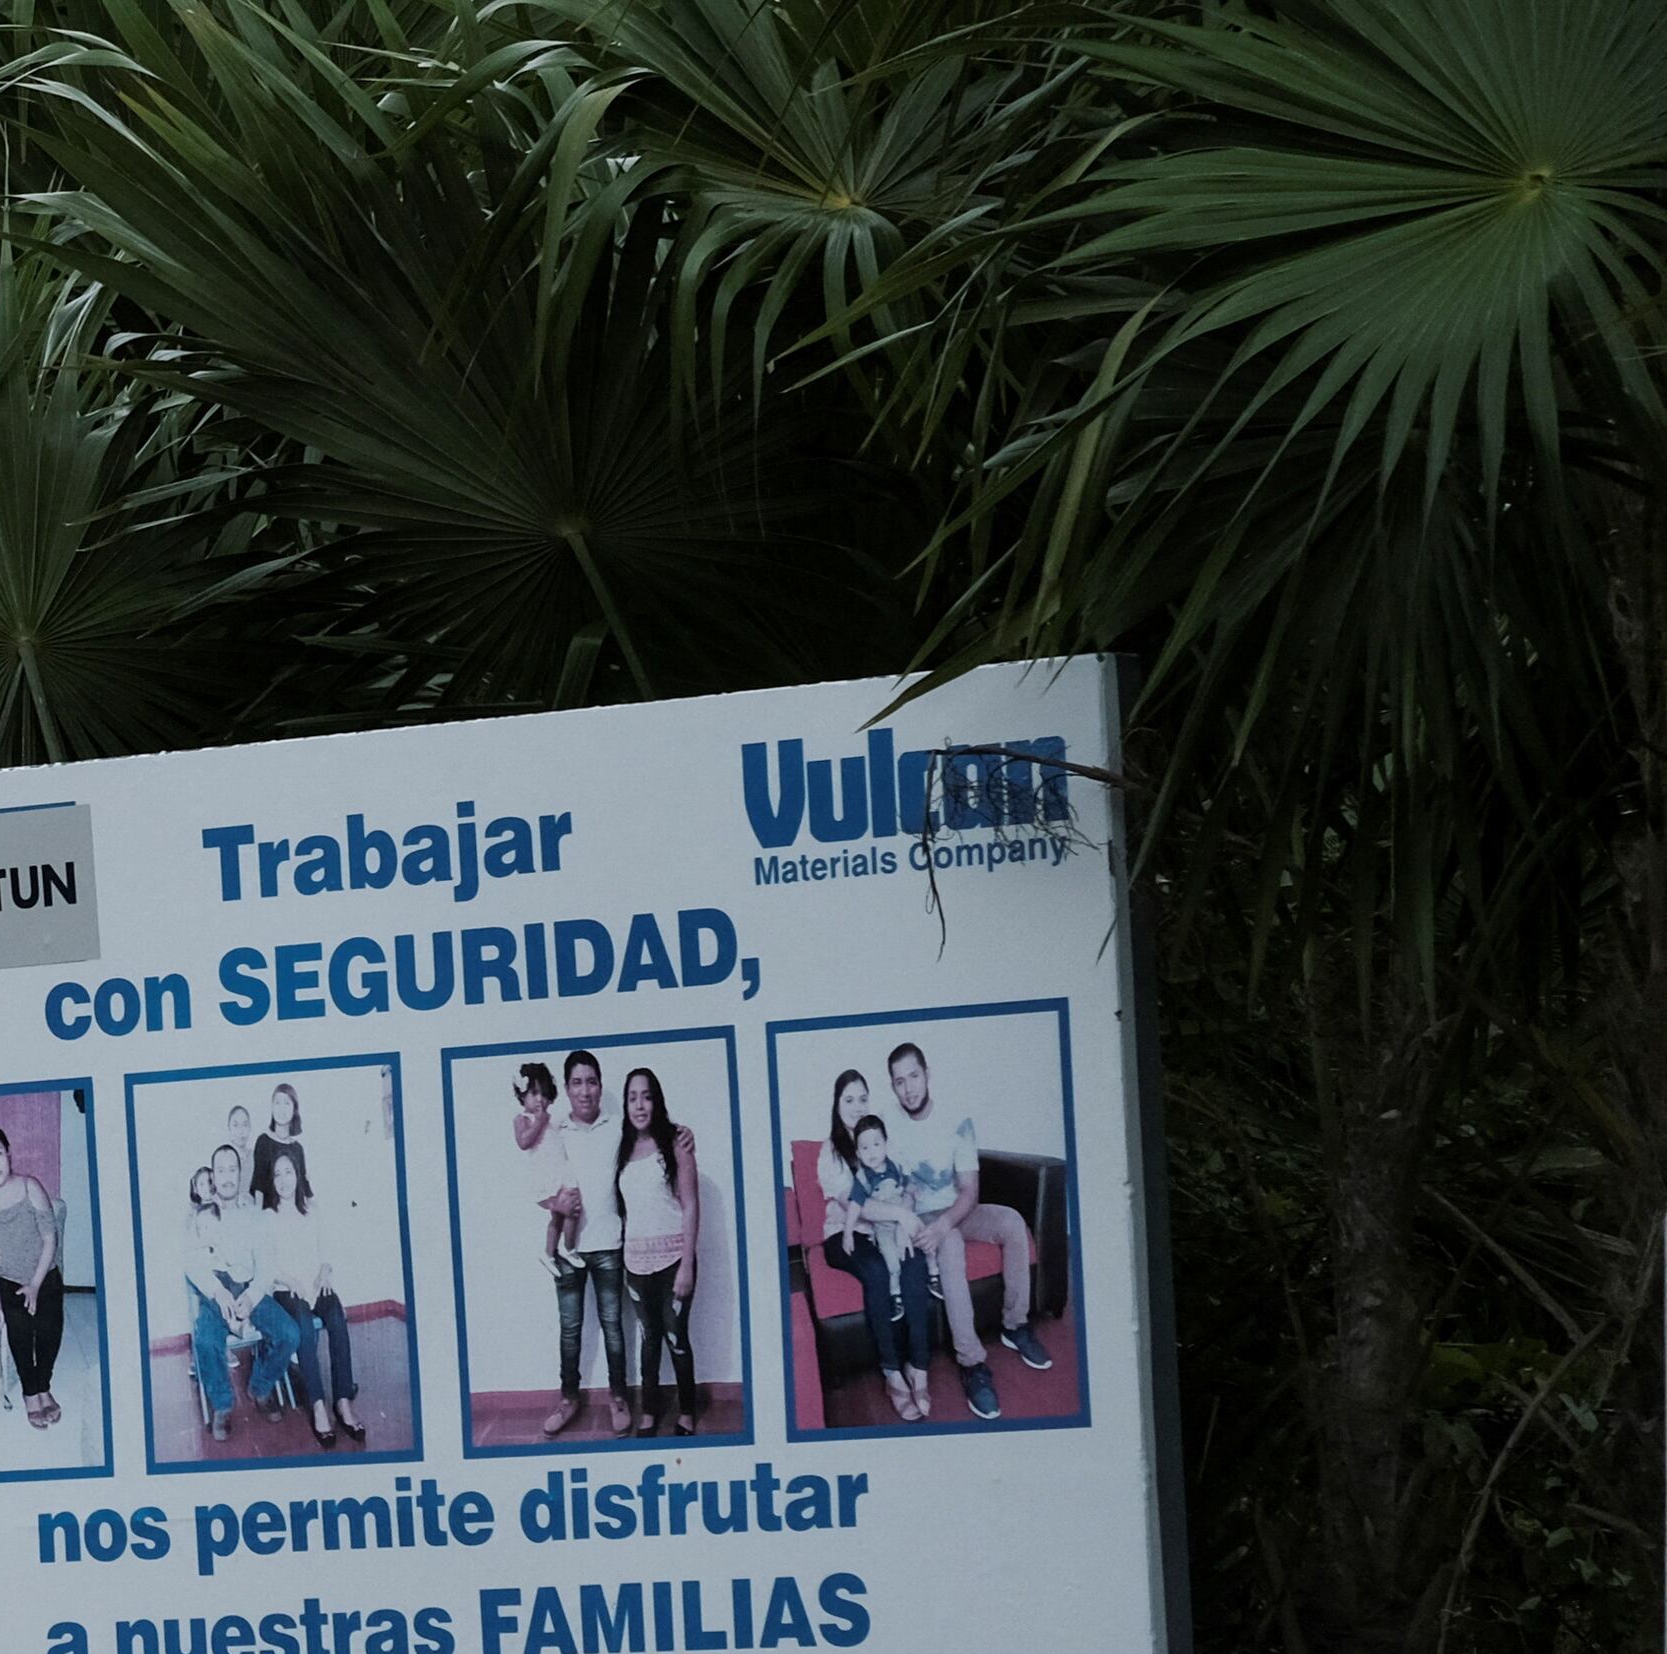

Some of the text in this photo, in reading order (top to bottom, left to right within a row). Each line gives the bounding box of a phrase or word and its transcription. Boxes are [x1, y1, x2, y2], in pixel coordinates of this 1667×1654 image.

[741, 728, 1069, 849] Vulcan
[202, 800, 573, 903] Trabajar
[754, 837, 1069, 886] Materials Company
[44, 907, 761, 1041] con SEGURIDAD,
[37, 1462, 869, 1577] nos permite disfrutar
